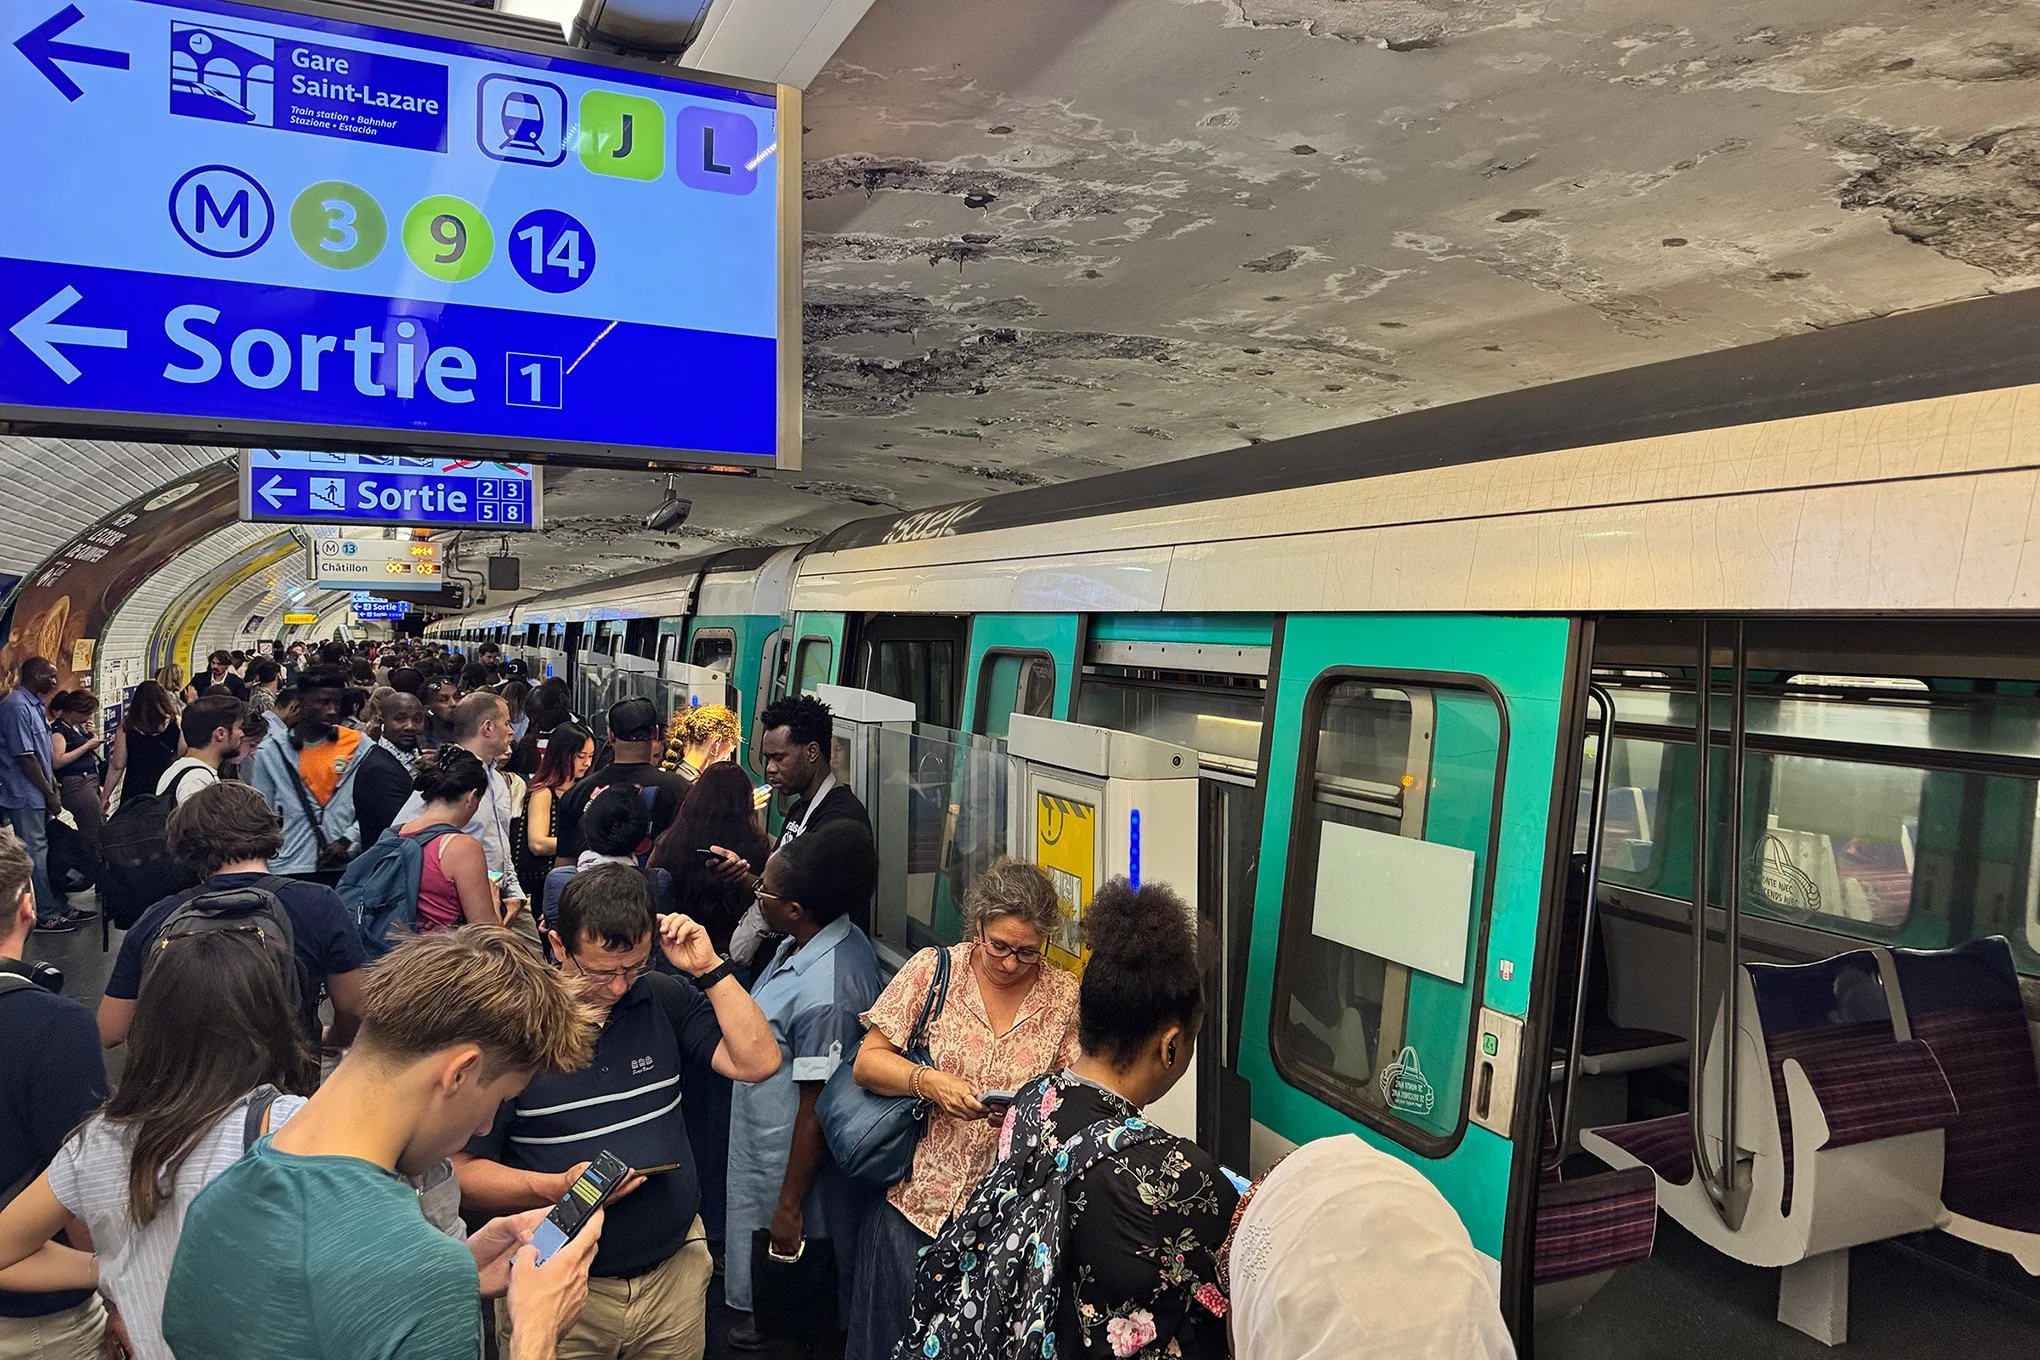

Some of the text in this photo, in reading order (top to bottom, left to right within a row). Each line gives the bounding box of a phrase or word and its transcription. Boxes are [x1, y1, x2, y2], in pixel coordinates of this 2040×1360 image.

[291, 48, 350, 75] Gare
[291, 74, 440, 115] Saint-Lazare
[289, 115, 378, 136] Stazione Estación
[290, 105, 398, 130] Train station Bahnhof
[612, 114, 731, 175] J L
[195, 184, 586, 279] M 3 9 14
[162, 303, 542, 404] Sortie 1
[357, 480, 468, 513] Sortie
[482, 482, 518, 498] 2 3
[483, 504, 519, 521] 5 8
[342, 544, 356, 554] 13
[321, 562, 368, 573] Châtillon
[416, 562, 434, 575] 03
[372, 602, 397, 611] Sortie
[286, 614, 310, 622] Alarme
